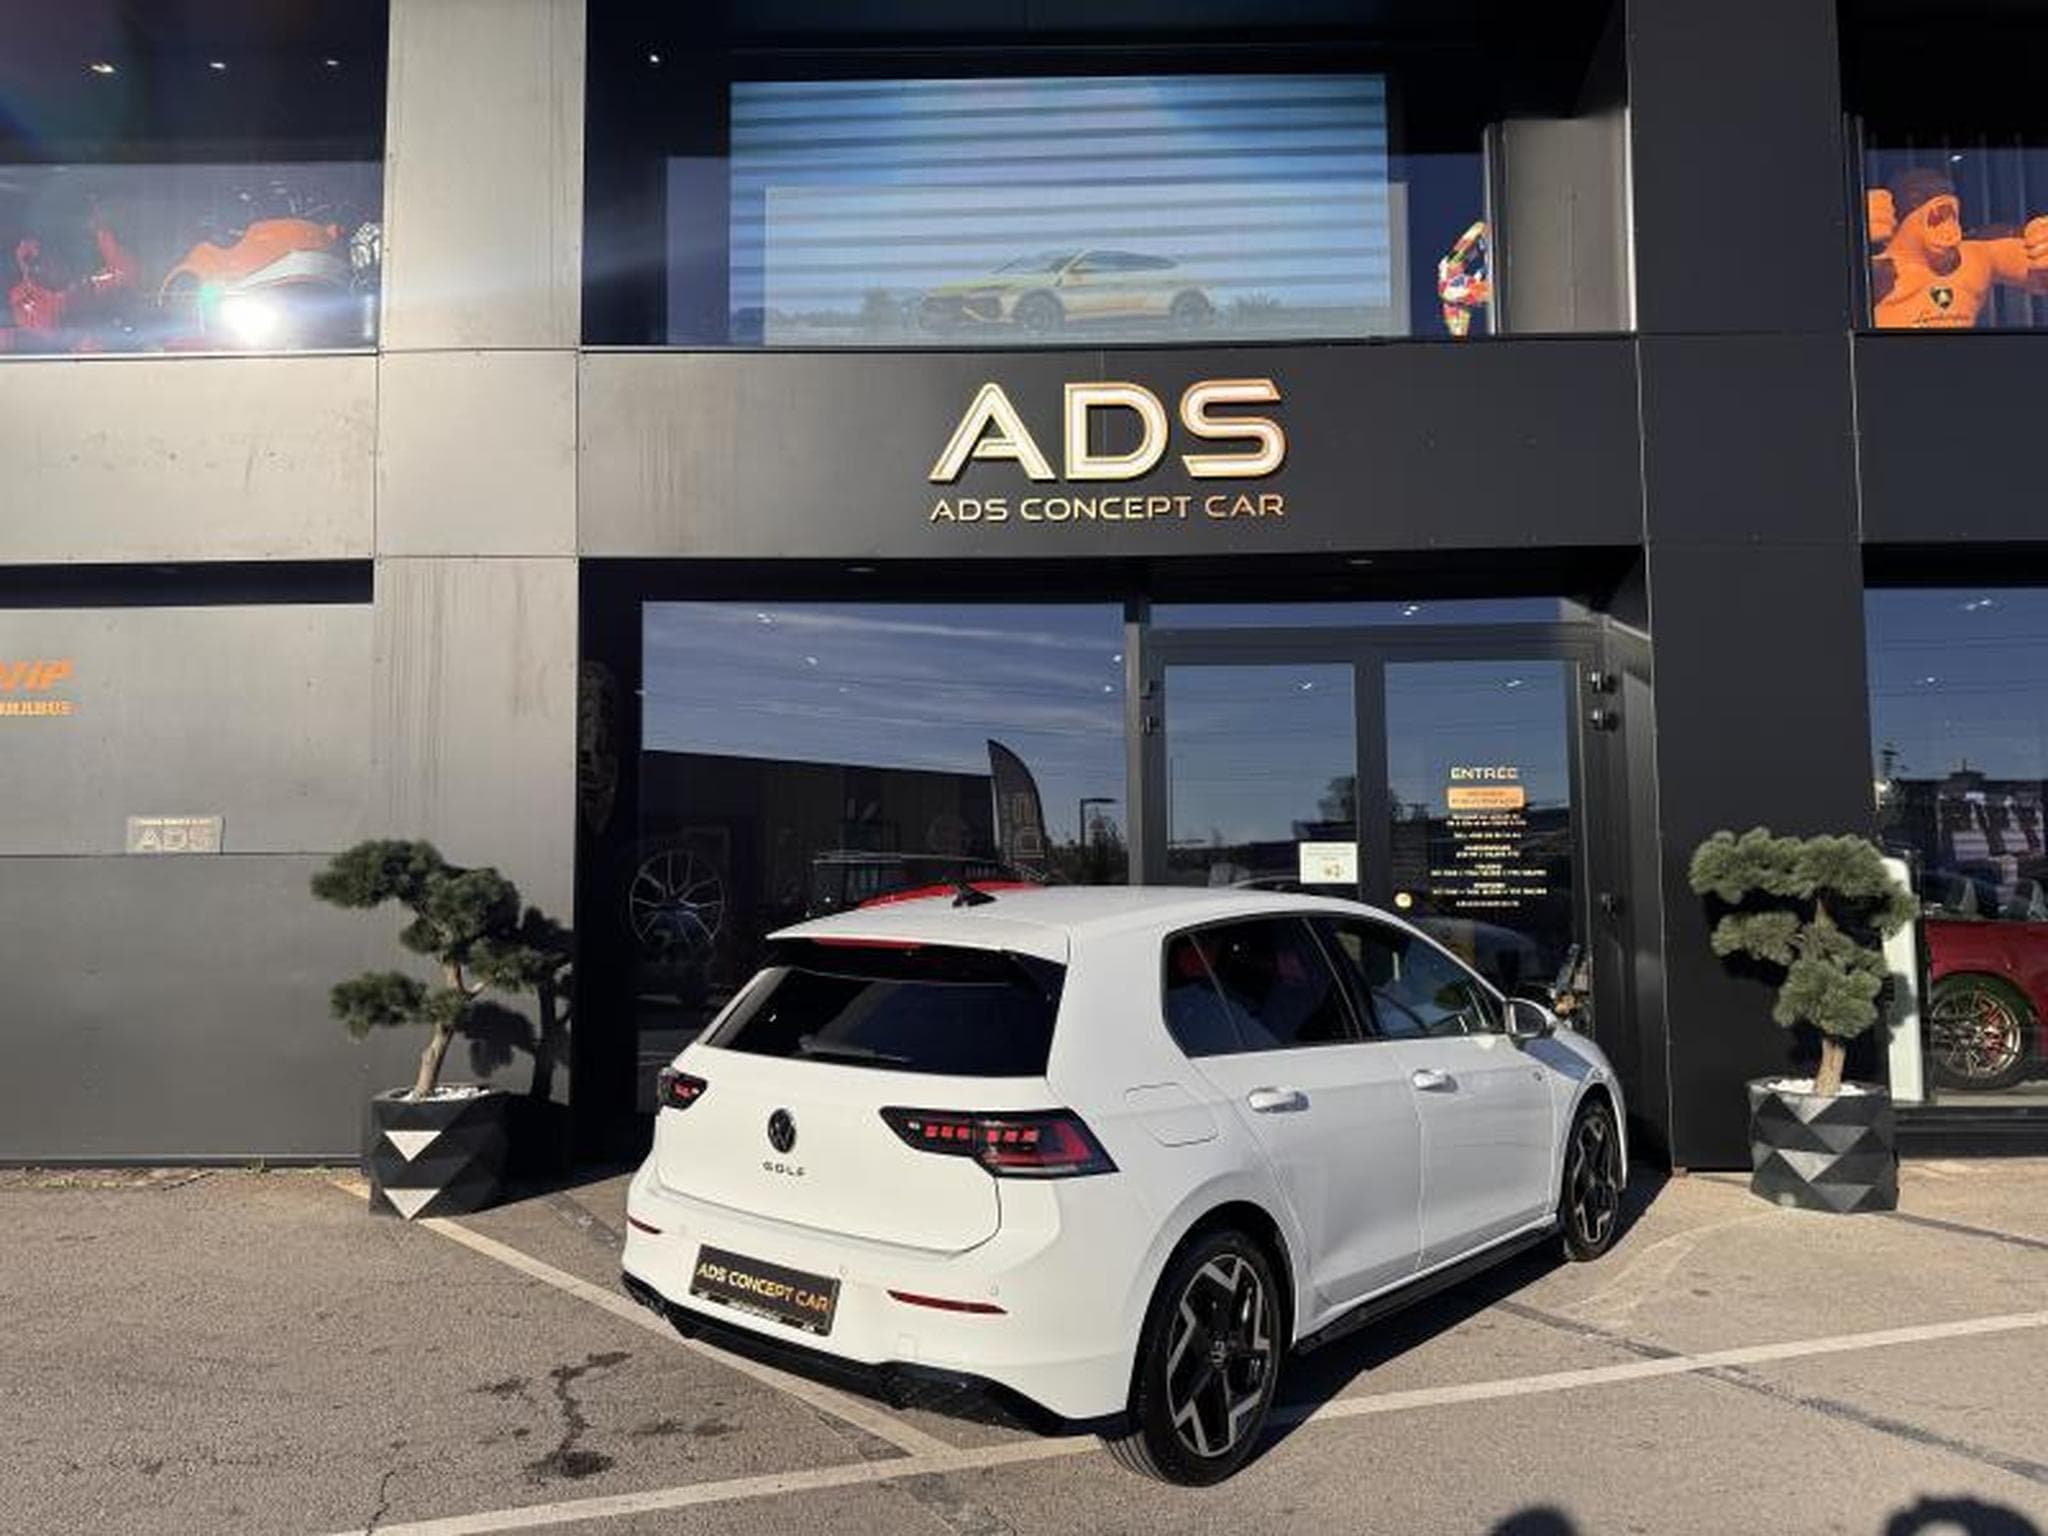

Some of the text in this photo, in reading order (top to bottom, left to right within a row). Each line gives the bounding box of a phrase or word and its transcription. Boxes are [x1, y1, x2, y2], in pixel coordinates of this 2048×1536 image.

[928, 378, 1286, 481] ADS
[930, 494, 1285, 522] ADS CONCEPT CAR
[762, 1161, 806, 1177] GOLF
[697, 1263, 831, 1311] ADS CONCEPT CAR
